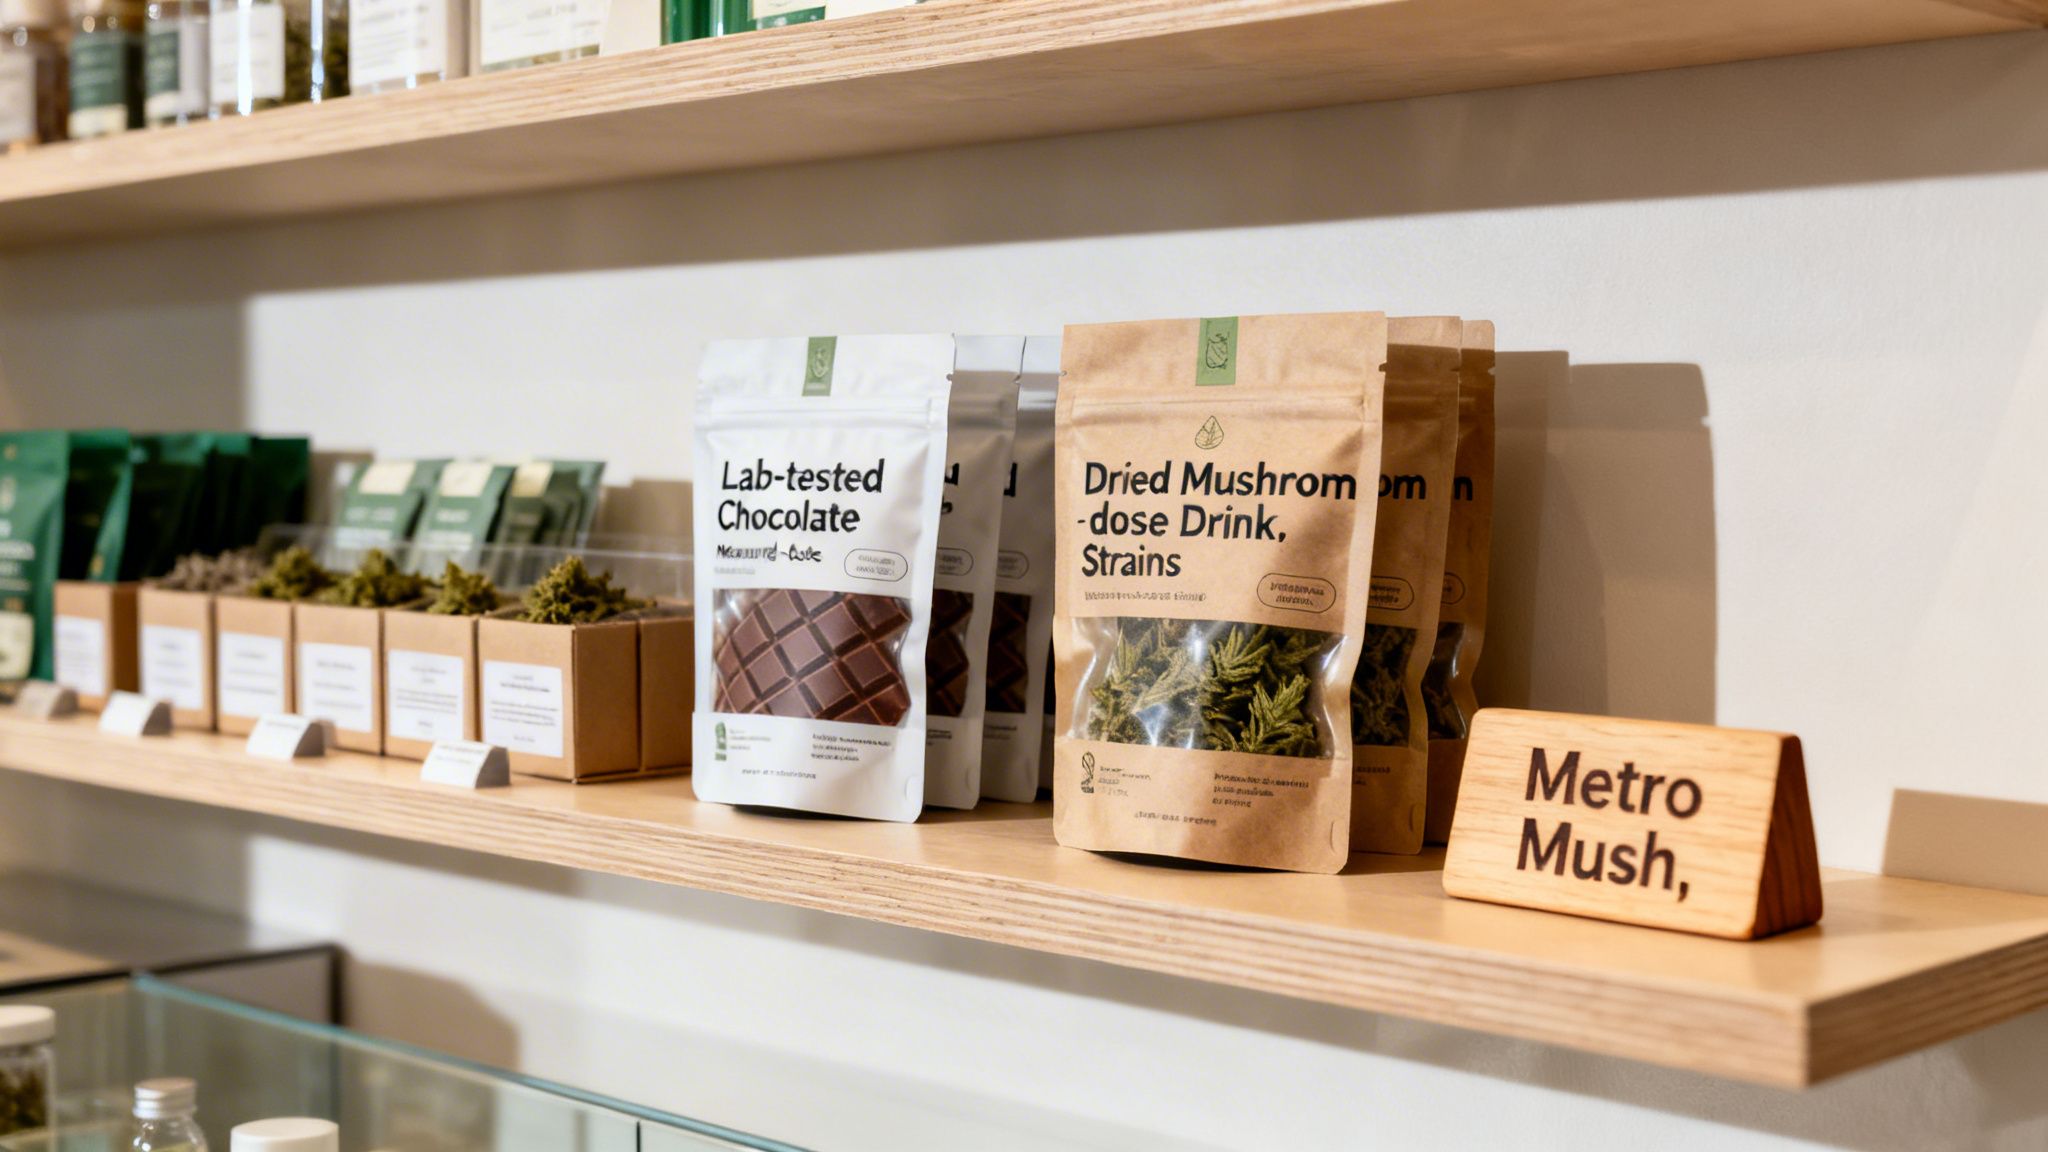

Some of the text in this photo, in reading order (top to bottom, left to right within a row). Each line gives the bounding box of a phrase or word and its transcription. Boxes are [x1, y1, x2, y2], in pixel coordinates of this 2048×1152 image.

[721, 457, 886, 494] Lab-tested
[1084, 460, 1172, 496] Dried
[1180, 460, 1357, 501] Mushrom
[717, 498, 861, 533] Chocolate
[1076, 500, 1287, 543] -dose Drink,
[1080, 542, 1182, 578] Strains
[1524, 746, 1703, 820] Metro
[1516, 817, 1691, 903] Mush,
